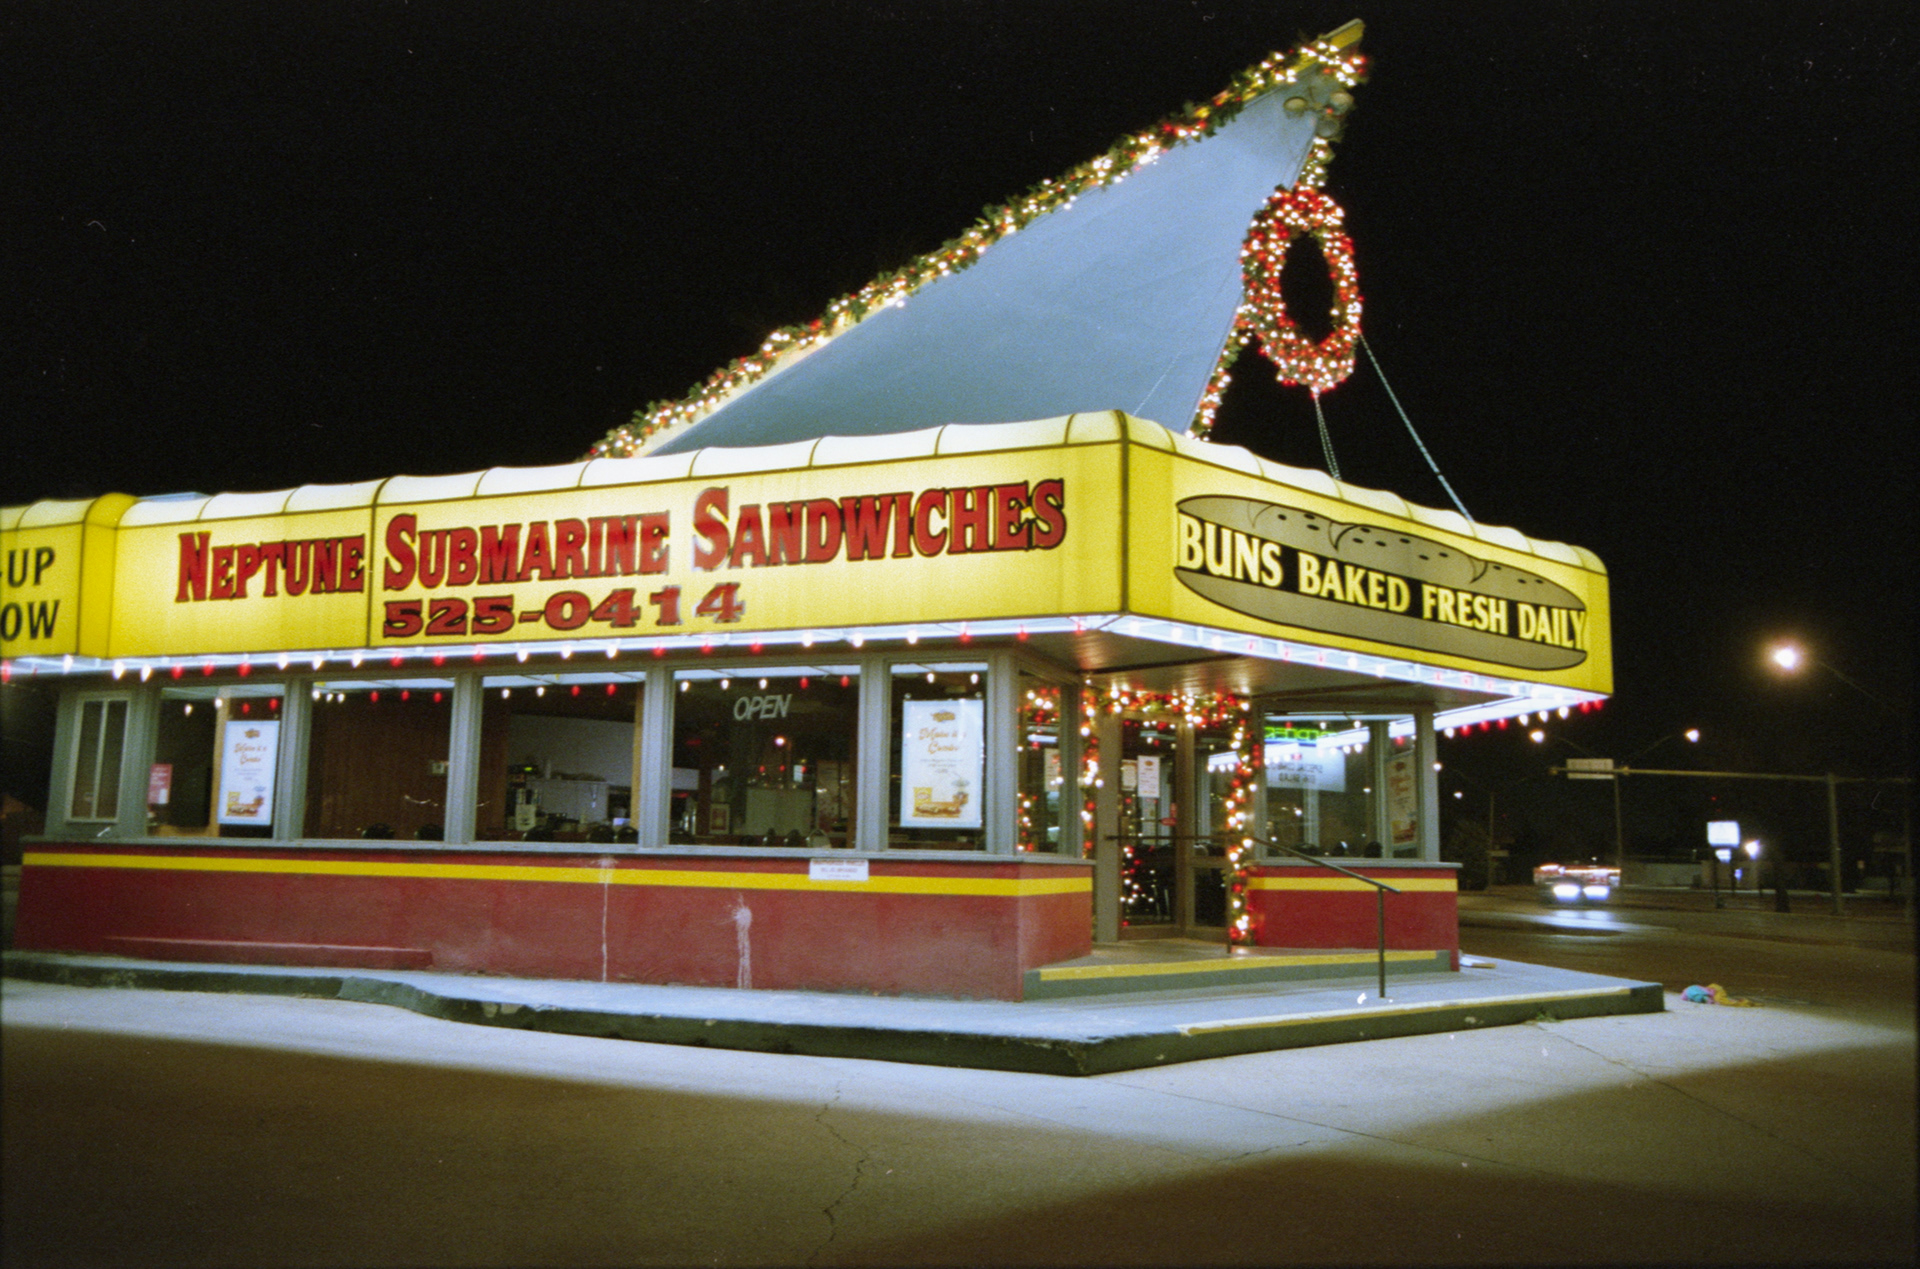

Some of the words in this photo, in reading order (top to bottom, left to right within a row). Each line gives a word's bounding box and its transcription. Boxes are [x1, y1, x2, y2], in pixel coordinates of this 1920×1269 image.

[0, 546, 56, 588] UP
[175, 531, 365, 603] NEPTUNE
[384, 510, 670, 592] SUBMARINE
[692, 478, 1067, 572] SANDWICHES
[383, 582, 744, 638] 525-0414
[1178, 513, 1284, 588] BUNS
[1298, 551, 1410, 613] BAKED
[1422, 583, 1508, 636] FRESH
[1517, 602, 1586, 652] DAILY
[733, 694, 793, 721] OPEN
